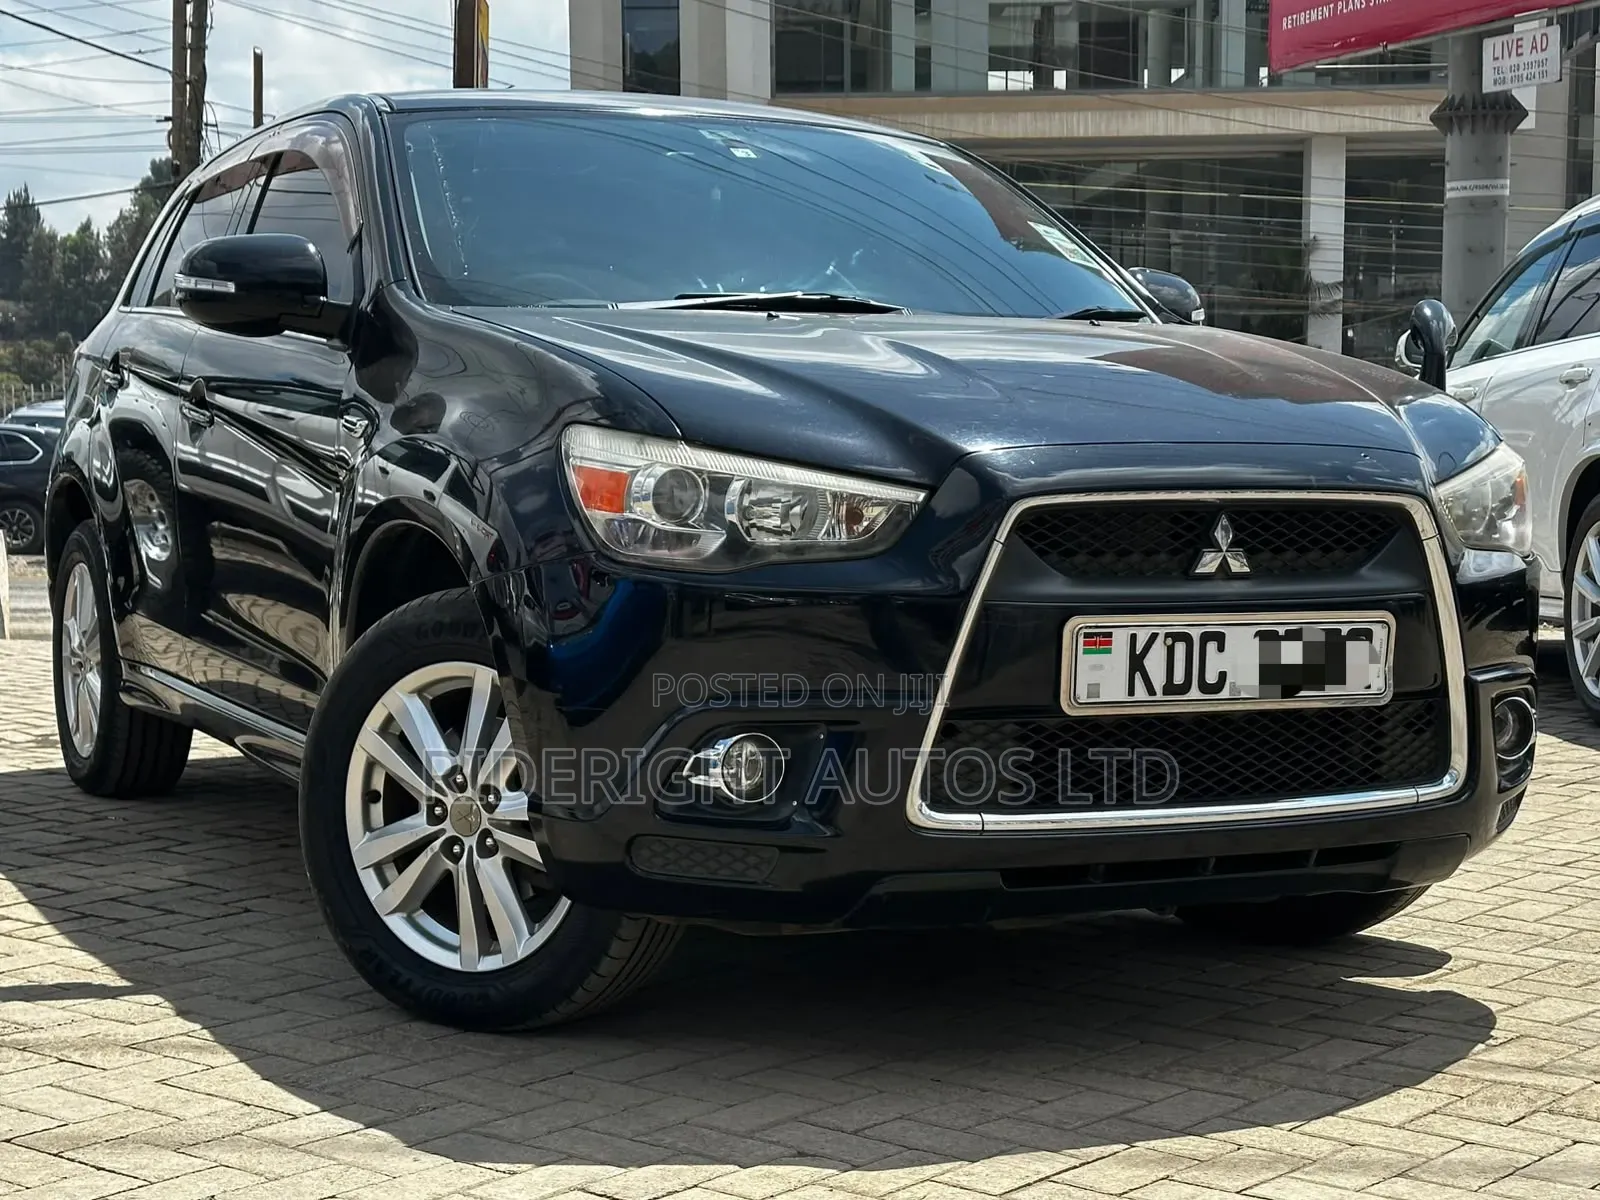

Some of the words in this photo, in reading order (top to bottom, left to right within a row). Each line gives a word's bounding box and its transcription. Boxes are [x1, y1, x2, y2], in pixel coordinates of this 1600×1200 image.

[1282, 3, 1335, 31] RETIREMENT
[1337, 0, 1366, 15] PLANS
[1493, 37, 1524, 61] LIVE
[1530, 32, 1549, 55] AD
[1509, 63, 1520, 74] 020
[1525, 71, 1536, 81] 424
[1127, 630, 1228, 697] KDC
